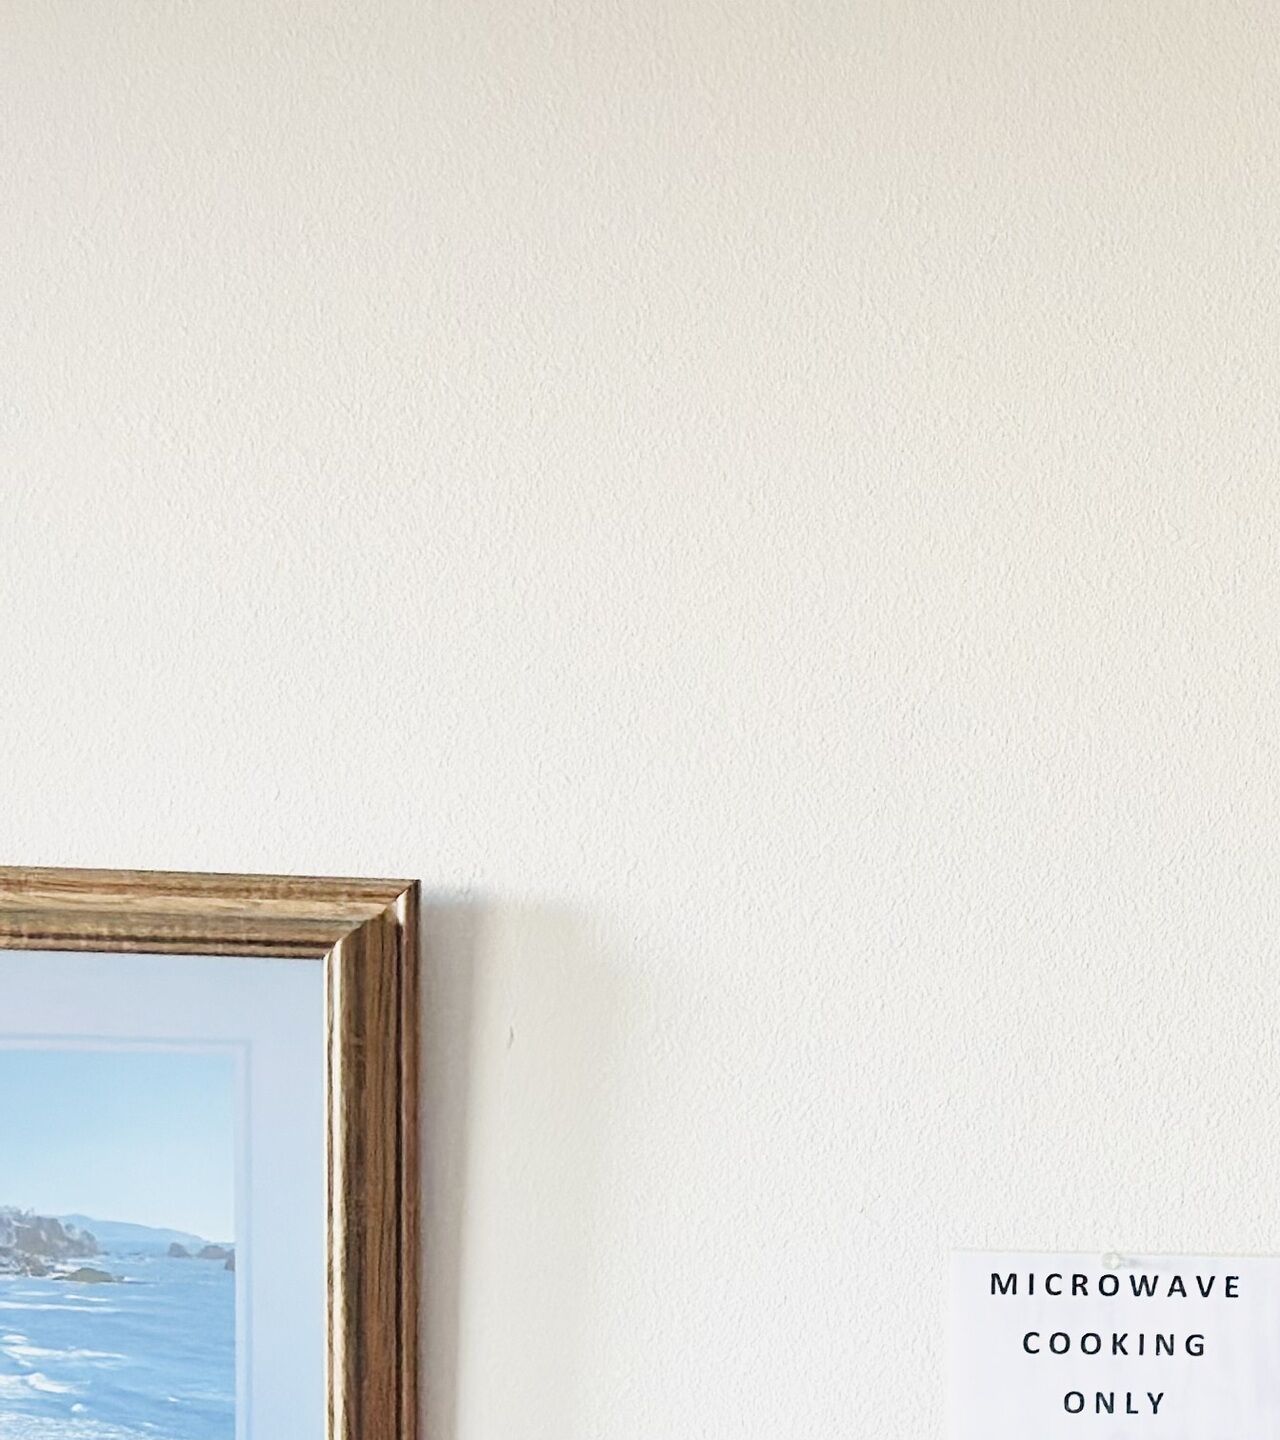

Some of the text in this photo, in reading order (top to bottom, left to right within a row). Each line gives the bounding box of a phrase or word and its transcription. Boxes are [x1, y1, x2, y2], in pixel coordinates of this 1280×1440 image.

[990, 1272, 1240, 1299] MICROWAVE
[1022, 1331, 1206, 1357] COOKING
[1063, 1391, 1165, 1415] ONLY
